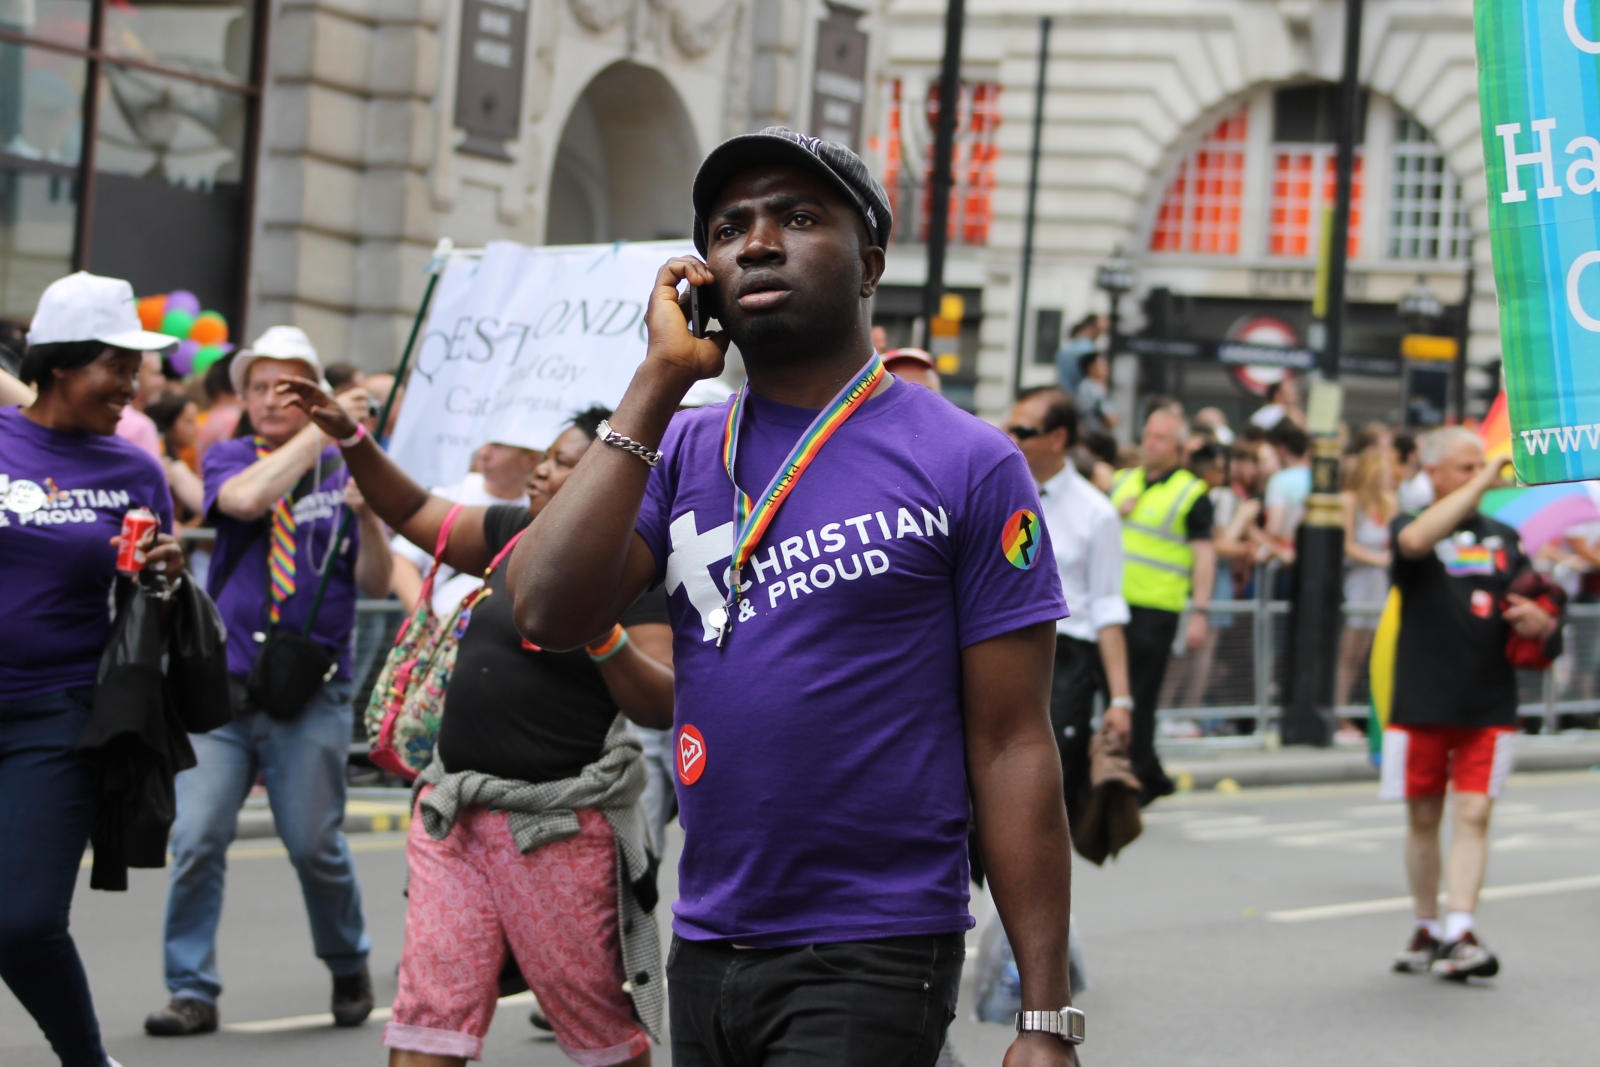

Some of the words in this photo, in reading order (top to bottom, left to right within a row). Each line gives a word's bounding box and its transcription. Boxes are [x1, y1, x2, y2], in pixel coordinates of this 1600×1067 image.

[842, 370, 877, 408] PRIDE
[764, 463, 800, 508] PRIDE
[18, 508, 98, 526] PROUD
[723, 505, 949, 593] CHRISTIAN
[738, 598, 757, 622] &
[768, 549, 890, 609] PROUD
